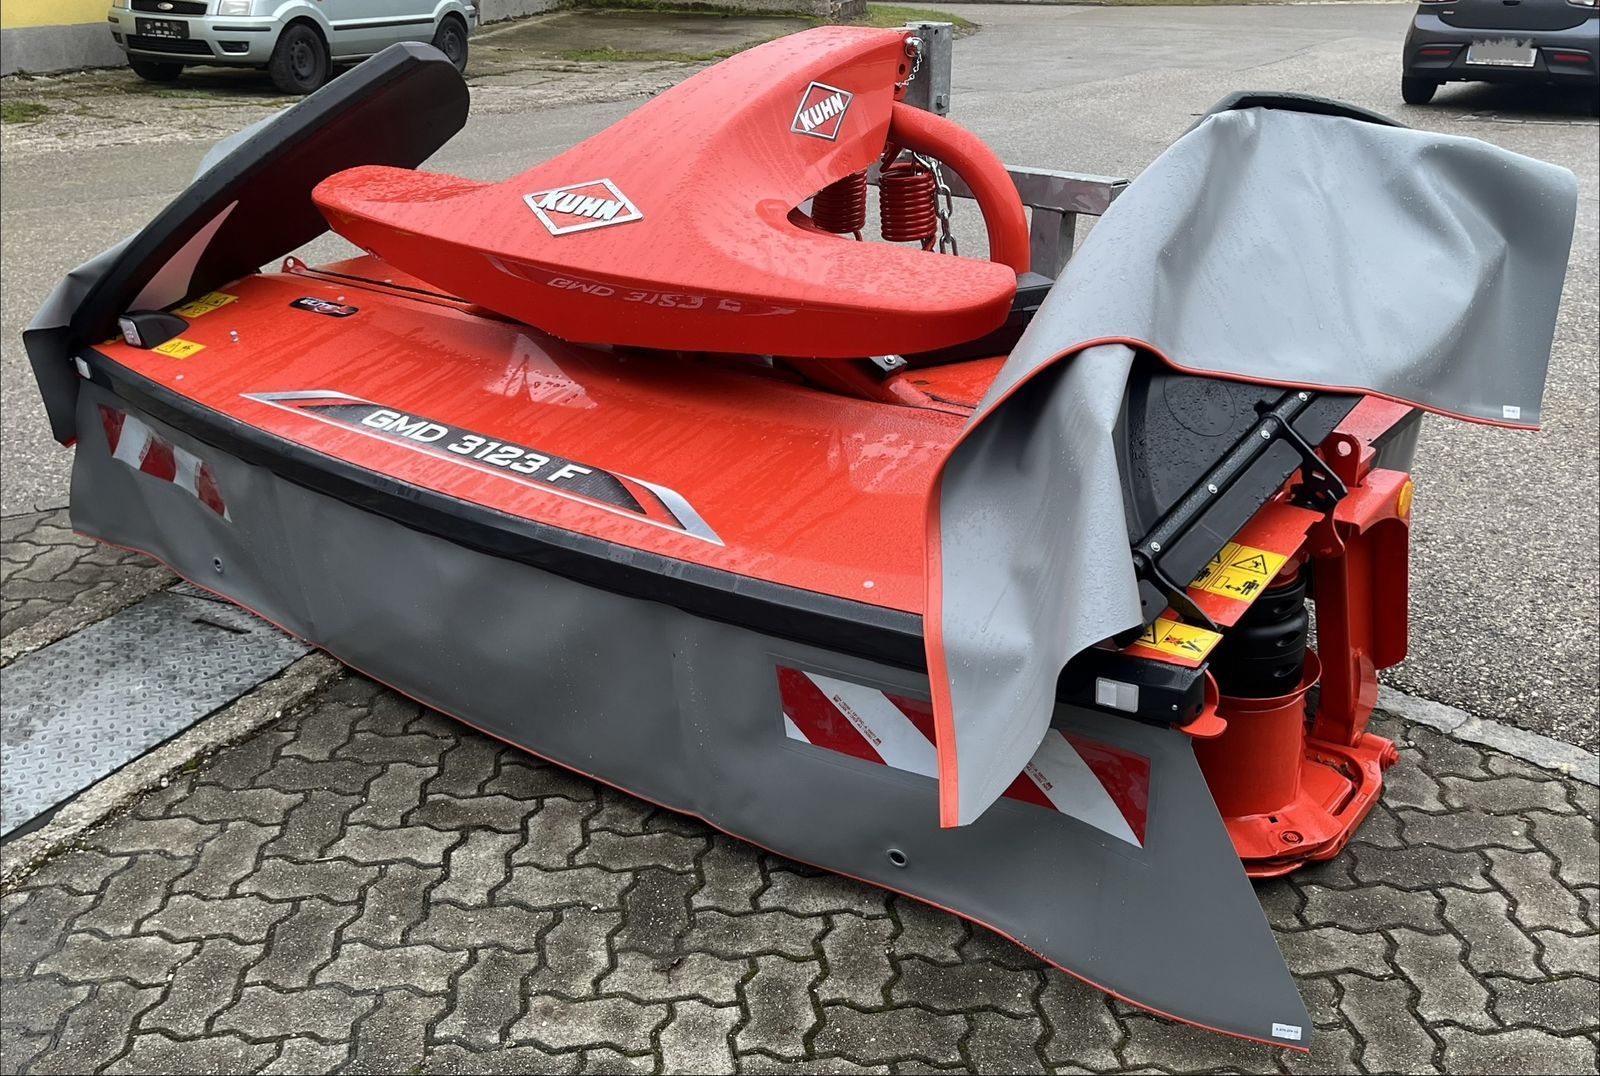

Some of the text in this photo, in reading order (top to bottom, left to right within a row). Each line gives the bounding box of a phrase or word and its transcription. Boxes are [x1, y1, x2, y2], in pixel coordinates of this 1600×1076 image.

[799, 92, 846, 132] KUHN
[537, 190, 625, 221] KUHN
[361, 409, 593, 482] GMD 3123 F
